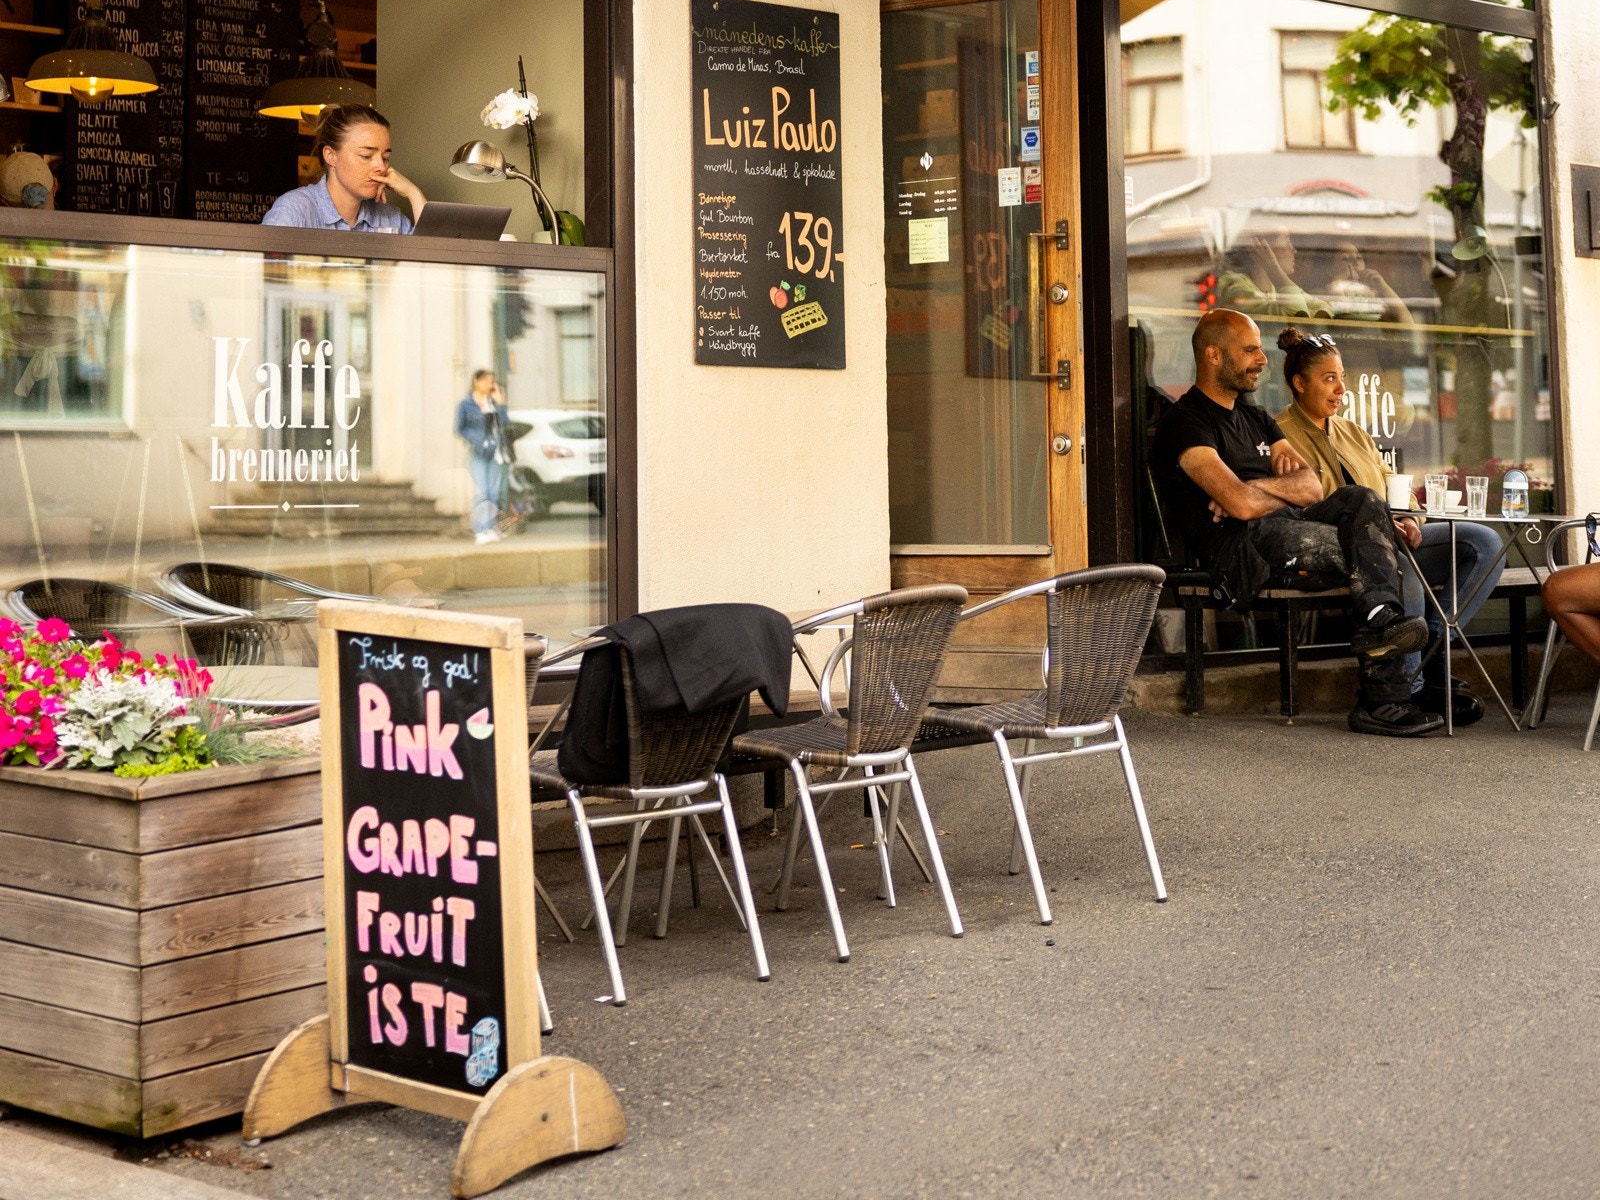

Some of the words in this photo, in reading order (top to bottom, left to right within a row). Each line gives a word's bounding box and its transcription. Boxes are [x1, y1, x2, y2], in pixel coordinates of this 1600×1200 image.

[221, 22, 244, 36] VANN
[131, 41, 160, 57] MOCCA
[794, 26, 829, 57] kaffe
[197, 42, 221, 57] PINK
[225, 44, 273, 60] GRAPEFRUIT
[197, 58, 246, 75] LIMONADE
[707, 56, 735, 71] Carmo
[736, 57, 747, 72] de
[774, 58, 806, 75] Brasil
[105, 99, 147, 114] HAMMER
[196, 94, 250, 109] KALDPRESSET
[78, 113, 119, 129] ISLATTE
[196, 120, 242, 134] SMOOTHIE
[703, 88, 767, 148] Luiz
[771, 86, 837, 153] Paulo
[77, 131, 122, 147] ISMOCCA
[77, 147, 114, 163] ISMOCCA
[114, 149, 157, 167] KARAMELL
[77, 163, 110, 182] SVART
[116, 166, 152, 185] KAFFE
[207, 171, 222, 185] TE
[793, 162, 801, 179] &
[163, 186, 171, 210] S
[699, 209, 714, 226] Gul
[697, 226, 748, 249] Prosessering
[766, 241, 780, 261] fra
[697, 305, 727, 320] Passer
[729, 306, 741, 320] til
[708, 324, 735, 337] Svart
[738, 323, 761, 341] kaffe
[210, 336, 361, 430] Kaffe
[1342, 373, 1397, 439] affe
[210, 436, 361, 483] brenneriet
[349, 636, 406, 671] Frisk
[412, 655, 432, 689] og
